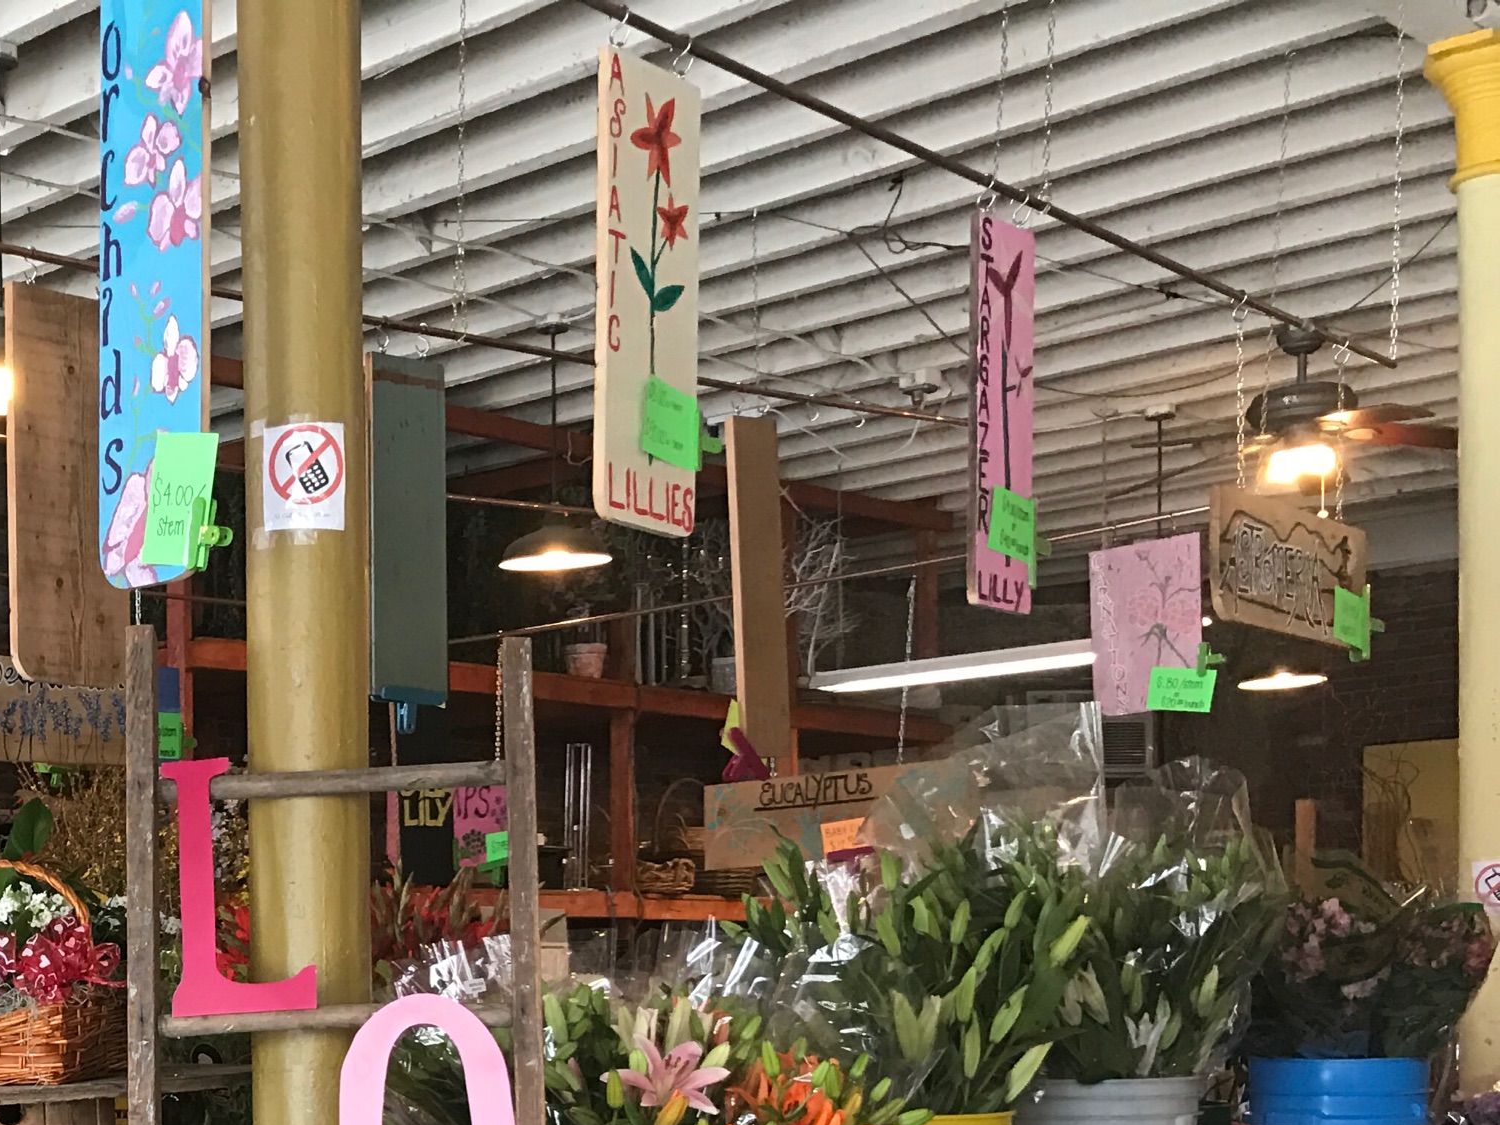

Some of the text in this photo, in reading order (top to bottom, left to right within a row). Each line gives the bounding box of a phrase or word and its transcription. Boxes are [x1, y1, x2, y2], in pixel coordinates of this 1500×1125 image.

[608, 52, 627, 353] ASIATIC
[977, 216, 995, 535] STARGAZER
[608, 461, 694, 534] LILLIES
[156, 514, 185, 537] stem
[977, 570, 1024, 612] LILLY
[403, 791, 454, 827] LILY
[758, 772, 874, 810] EUCALYPTUS
